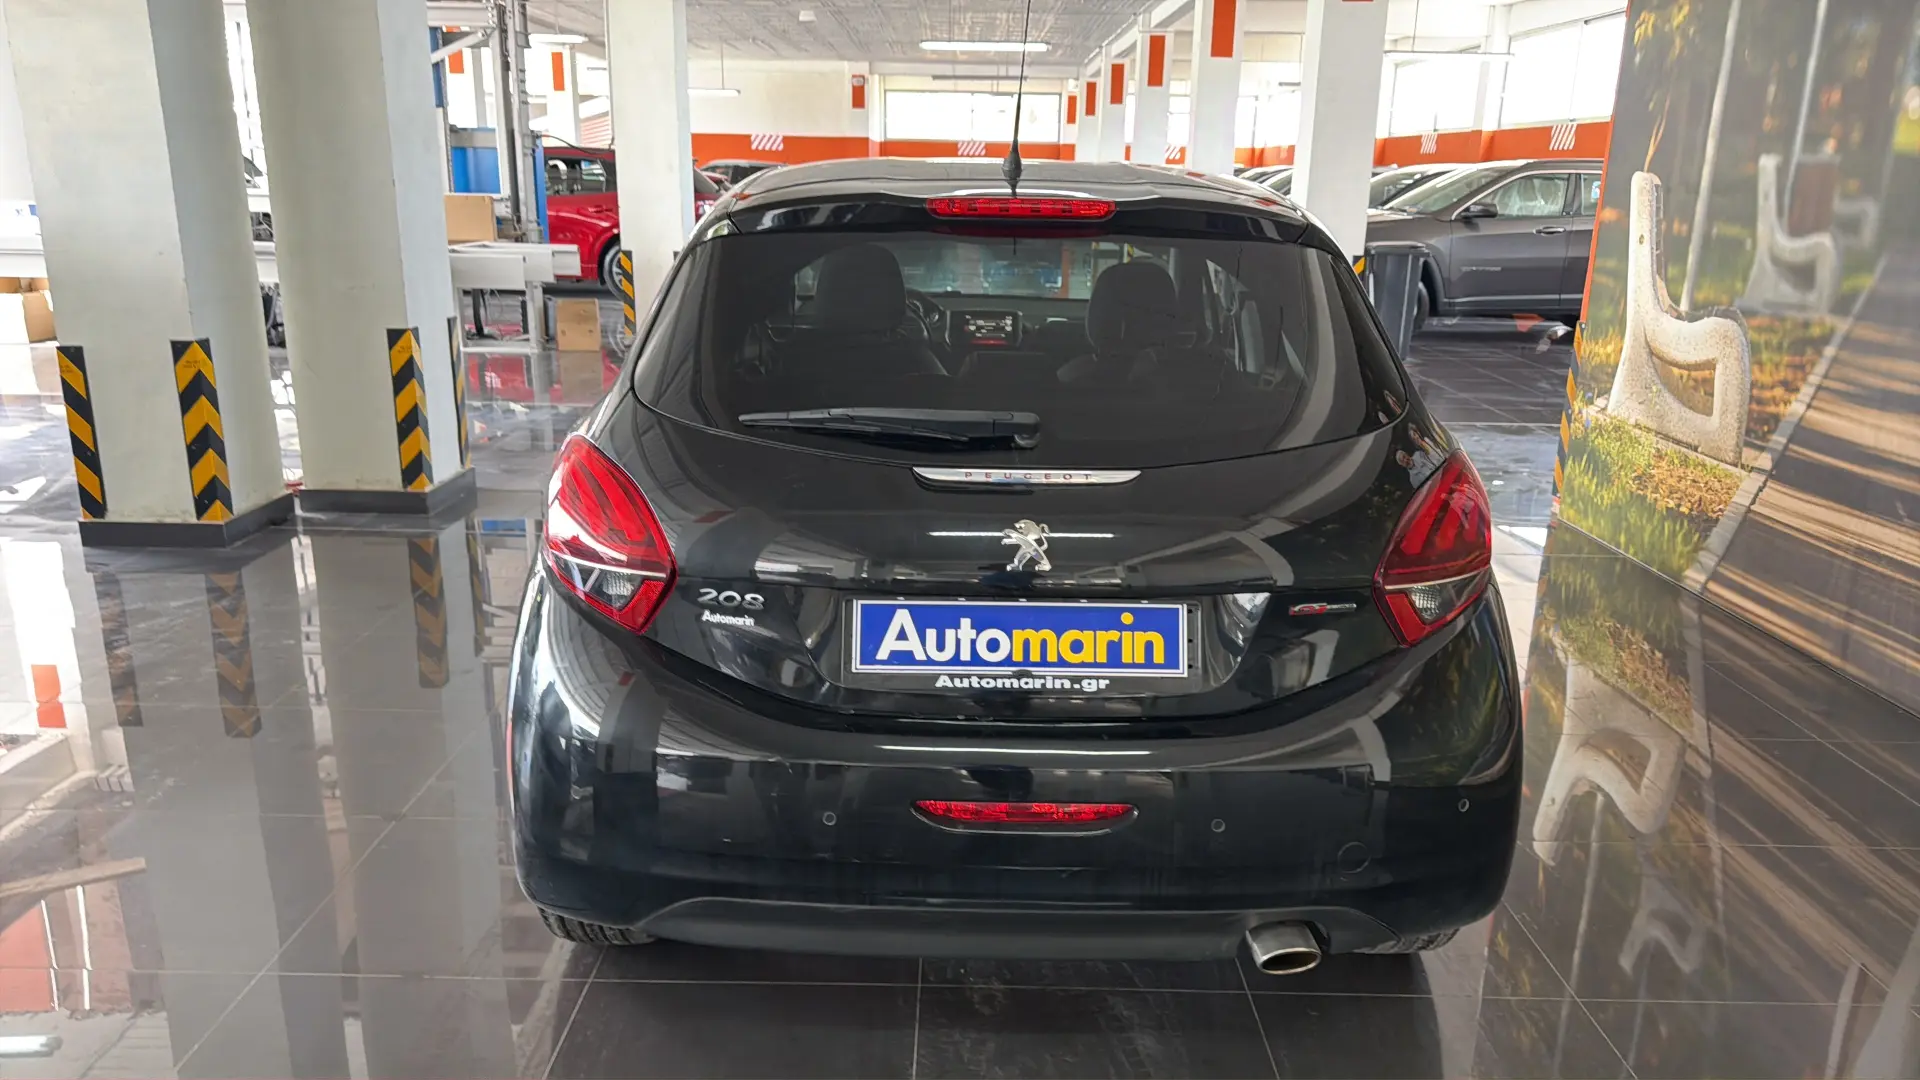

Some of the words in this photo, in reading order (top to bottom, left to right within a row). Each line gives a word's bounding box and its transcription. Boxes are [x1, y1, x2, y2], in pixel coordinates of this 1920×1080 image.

[964, 471, 1093, 481] PEUGEOT
[697, 588, 765, 610] 208
[701, 609, 755, 626] Automarin
[875, 608, 1165, 664] Automarin
[934, 674, 1110, 692] Automarin.gr
